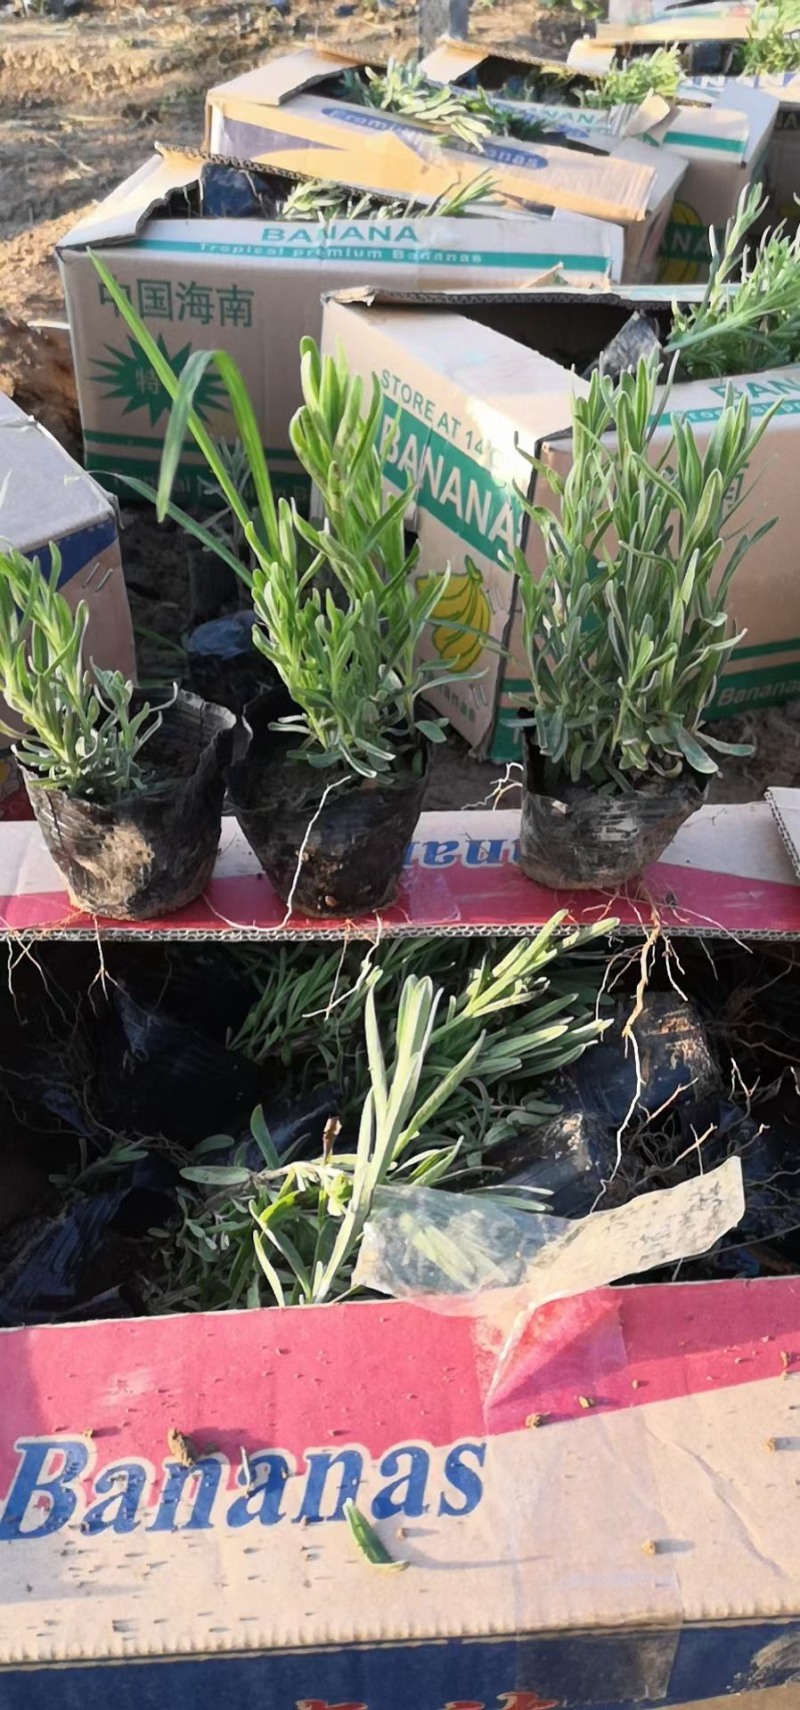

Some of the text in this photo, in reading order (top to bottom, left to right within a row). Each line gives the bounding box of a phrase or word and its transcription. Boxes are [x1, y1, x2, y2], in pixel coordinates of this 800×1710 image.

[201, 243, 482, 263] Tropical premium Bananas
[261, 225, 418, 242] BANANA
[98, 275, 255, 327] 中国海南
[381, 369, 435, 423] STORE
[437, 412, 461, 440] AT
[380, 413, 514, 557] BANANA
[717, 680, 800, 707] Banana
[0, 1442, 487, 1541] Bananas
